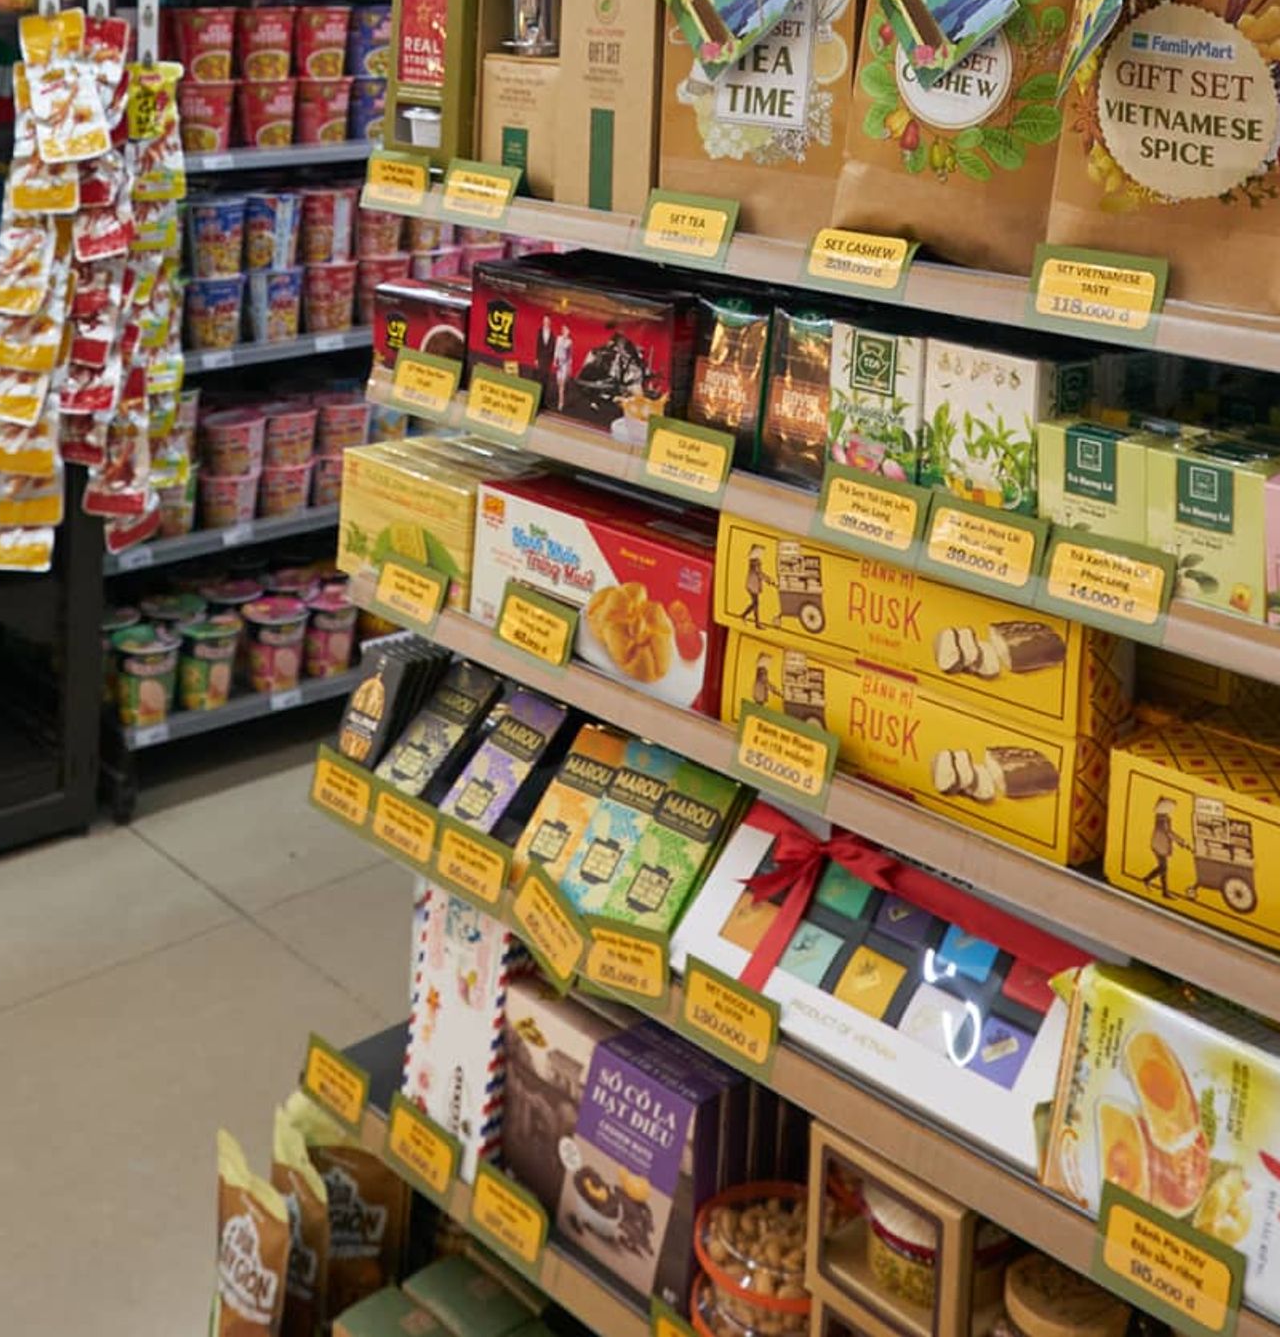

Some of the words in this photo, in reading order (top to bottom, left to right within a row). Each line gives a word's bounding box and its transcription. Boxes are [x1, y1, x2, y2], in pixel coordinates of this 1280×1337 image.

[403, 36, 441, 54] REAL
[1151, 33, 1235, 61] FamilyMart
[738, 47, 794, 77] TEA
[1115, 61, 1183, 96] GIFT
[1190, 71, 1255, 103] SET
[725, 82, 795, 119] TIME
[1104, 99, 1264, 142] VIETNAMESE
[1139, 136, 1215, 168] SPICE
[689, 215, 706, 229] TEA
[824, 237, 843, 252] SET
[846, 239, 896, 261] CASHEW
[946, 544, 994, 571] 39.000
[847, 580, 924, 643] RUSK
[1069, 582, 1120, 609] 14.000
[499, 717, 546, 750] MAROU
[848, 696, 922, 762] RUSK
[568, 754, 614, 787] MAROU
[612, 768, 666, 801] MAROU
[664, 793, 717, 829] MAROU
